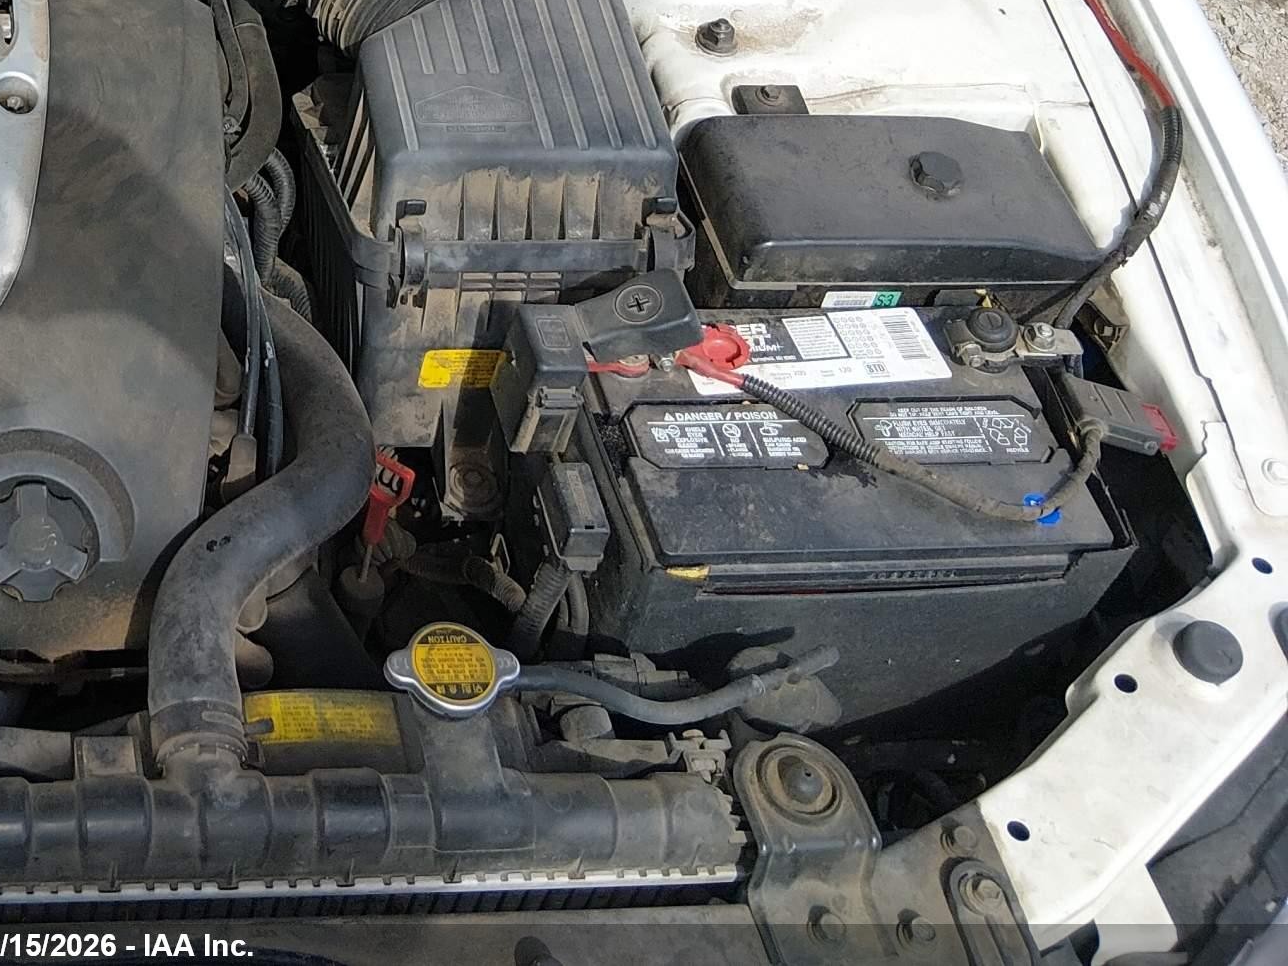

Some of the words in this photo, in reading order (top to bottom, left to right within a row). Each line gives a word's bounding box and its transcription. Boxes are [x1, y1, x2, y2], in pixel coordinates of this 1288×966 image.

[675, 412, 724, 421] DANGER
[733, 411, 778, 421] POISON
[427, 634, 468, 644] CAUTION
